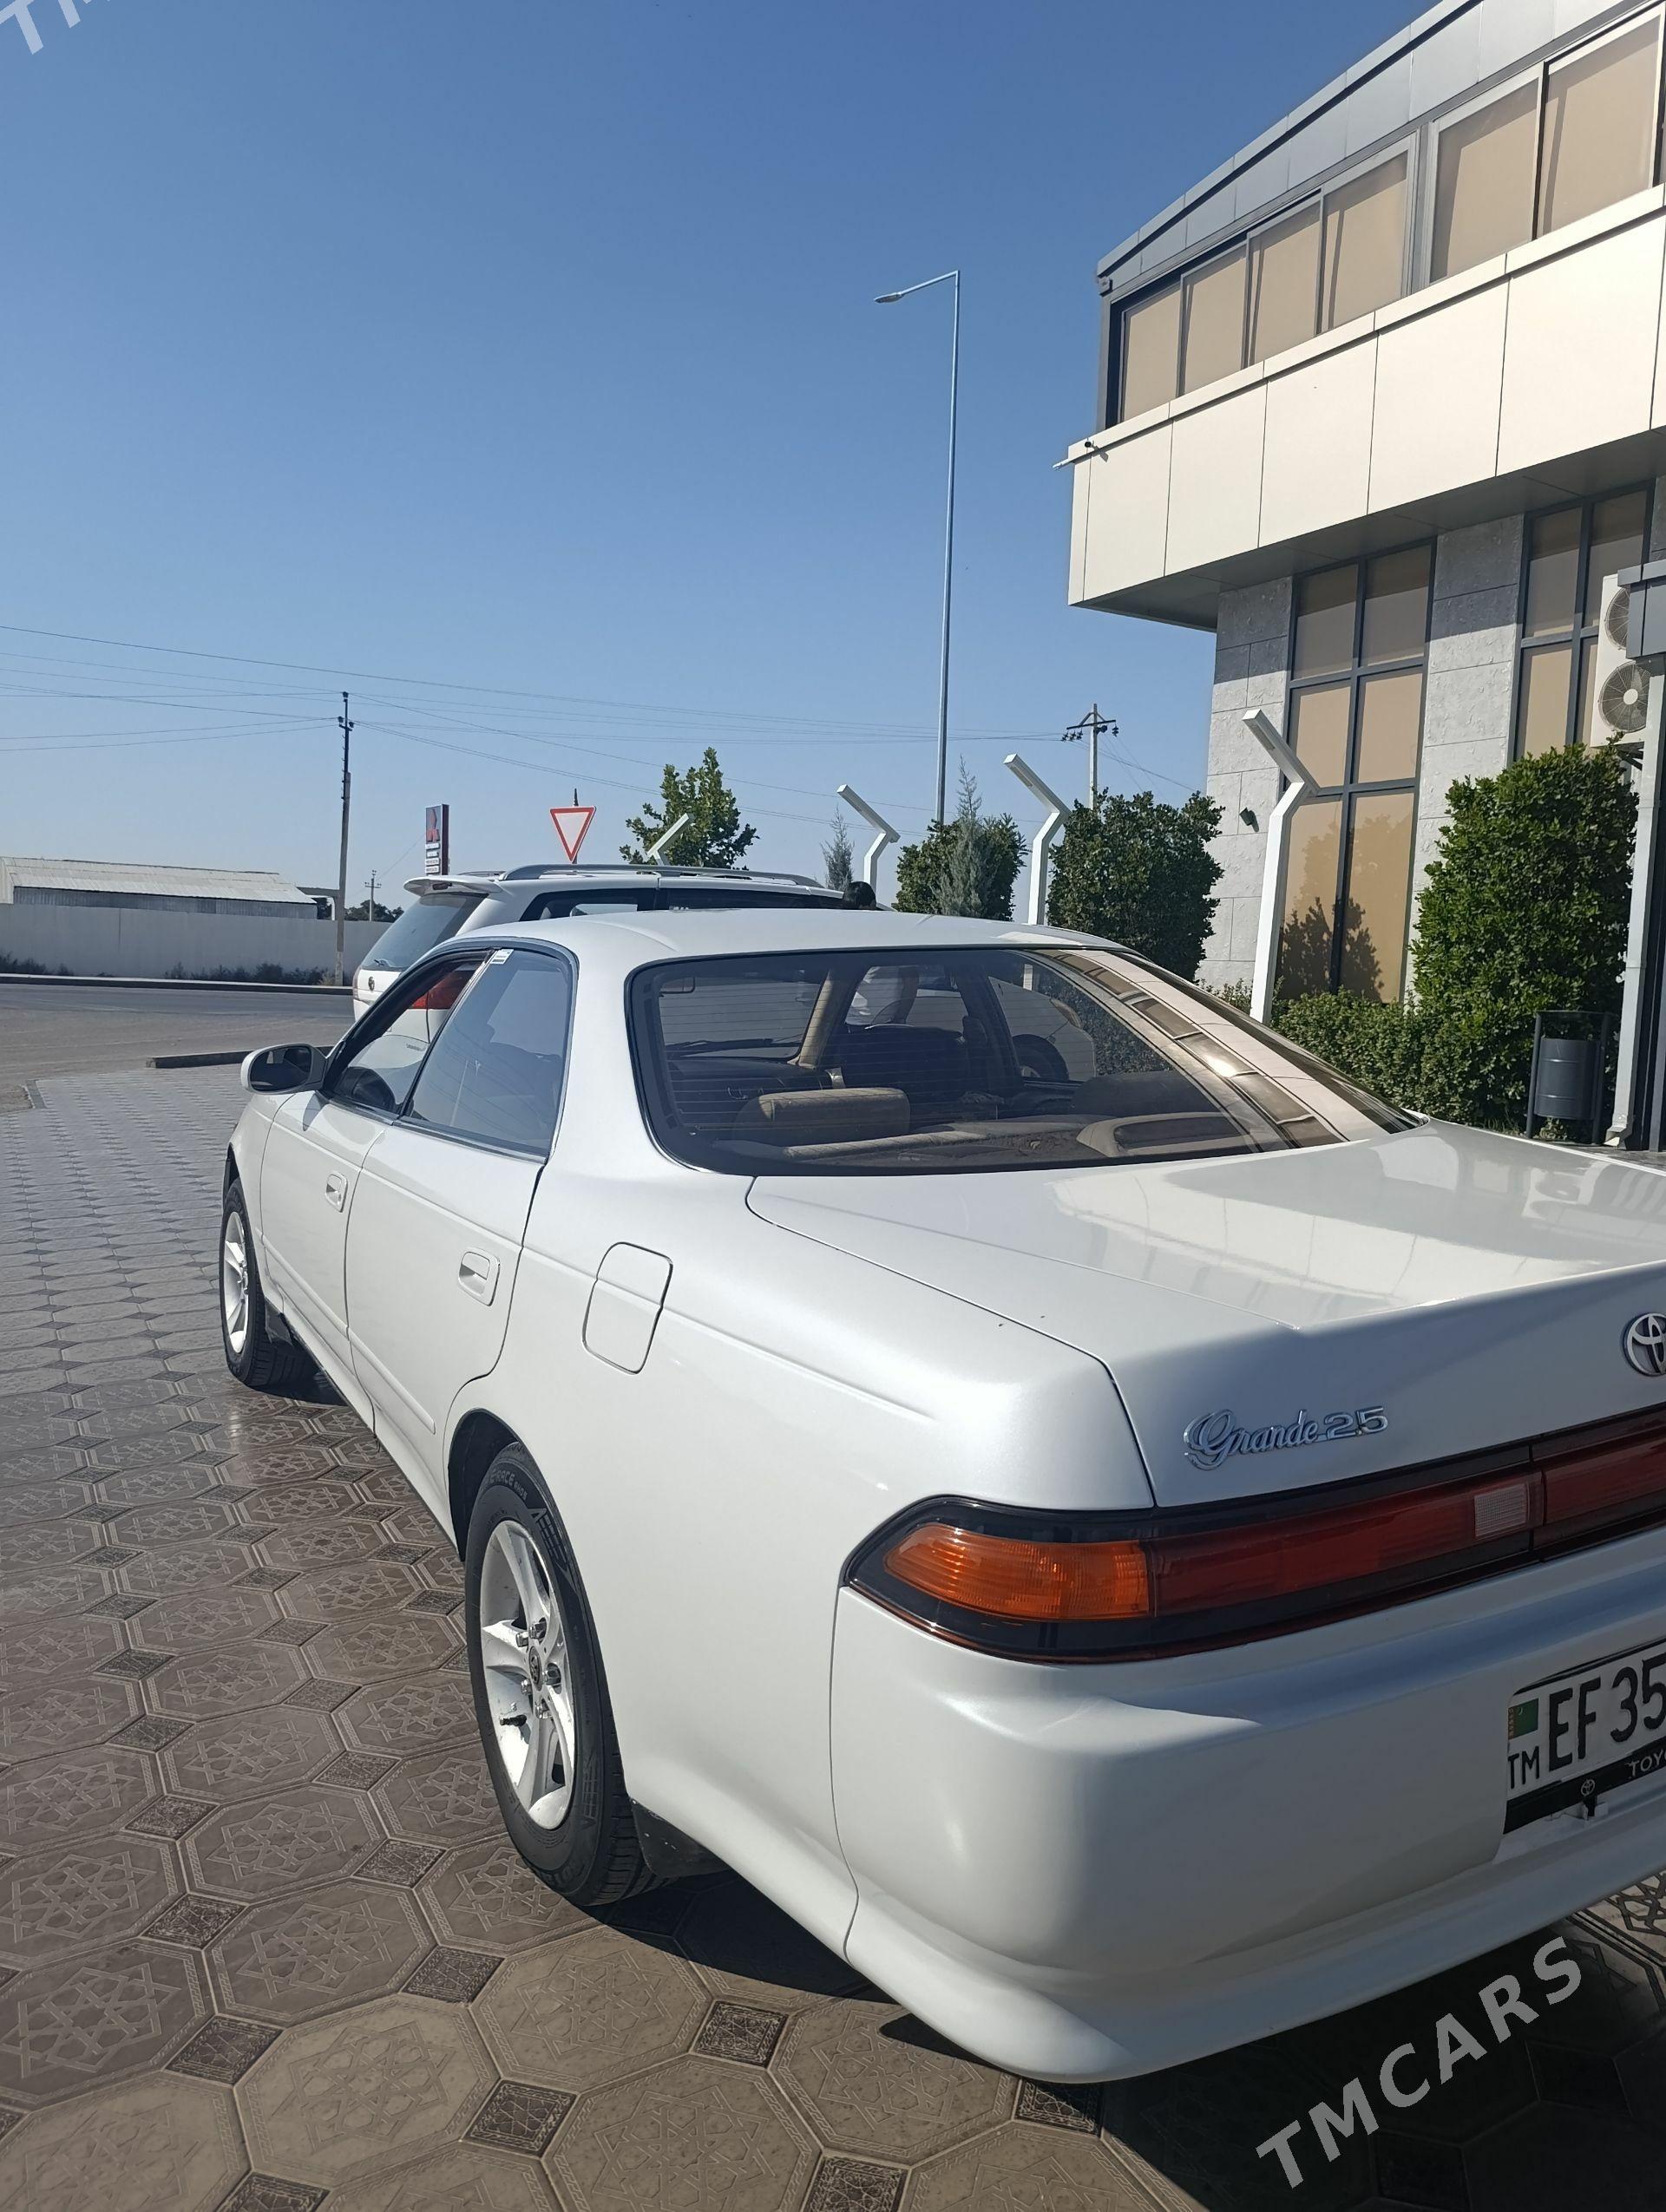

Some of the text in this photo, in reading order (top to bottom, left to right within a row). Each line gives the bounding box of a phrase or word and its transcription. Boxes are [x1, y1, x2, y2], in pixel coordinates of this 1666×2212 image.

[1184, 1409, 1319, 1470] Grande
[1507, 1745, 1540, 1790] TM
[1623, 1748, 1666, 1777] TOY
